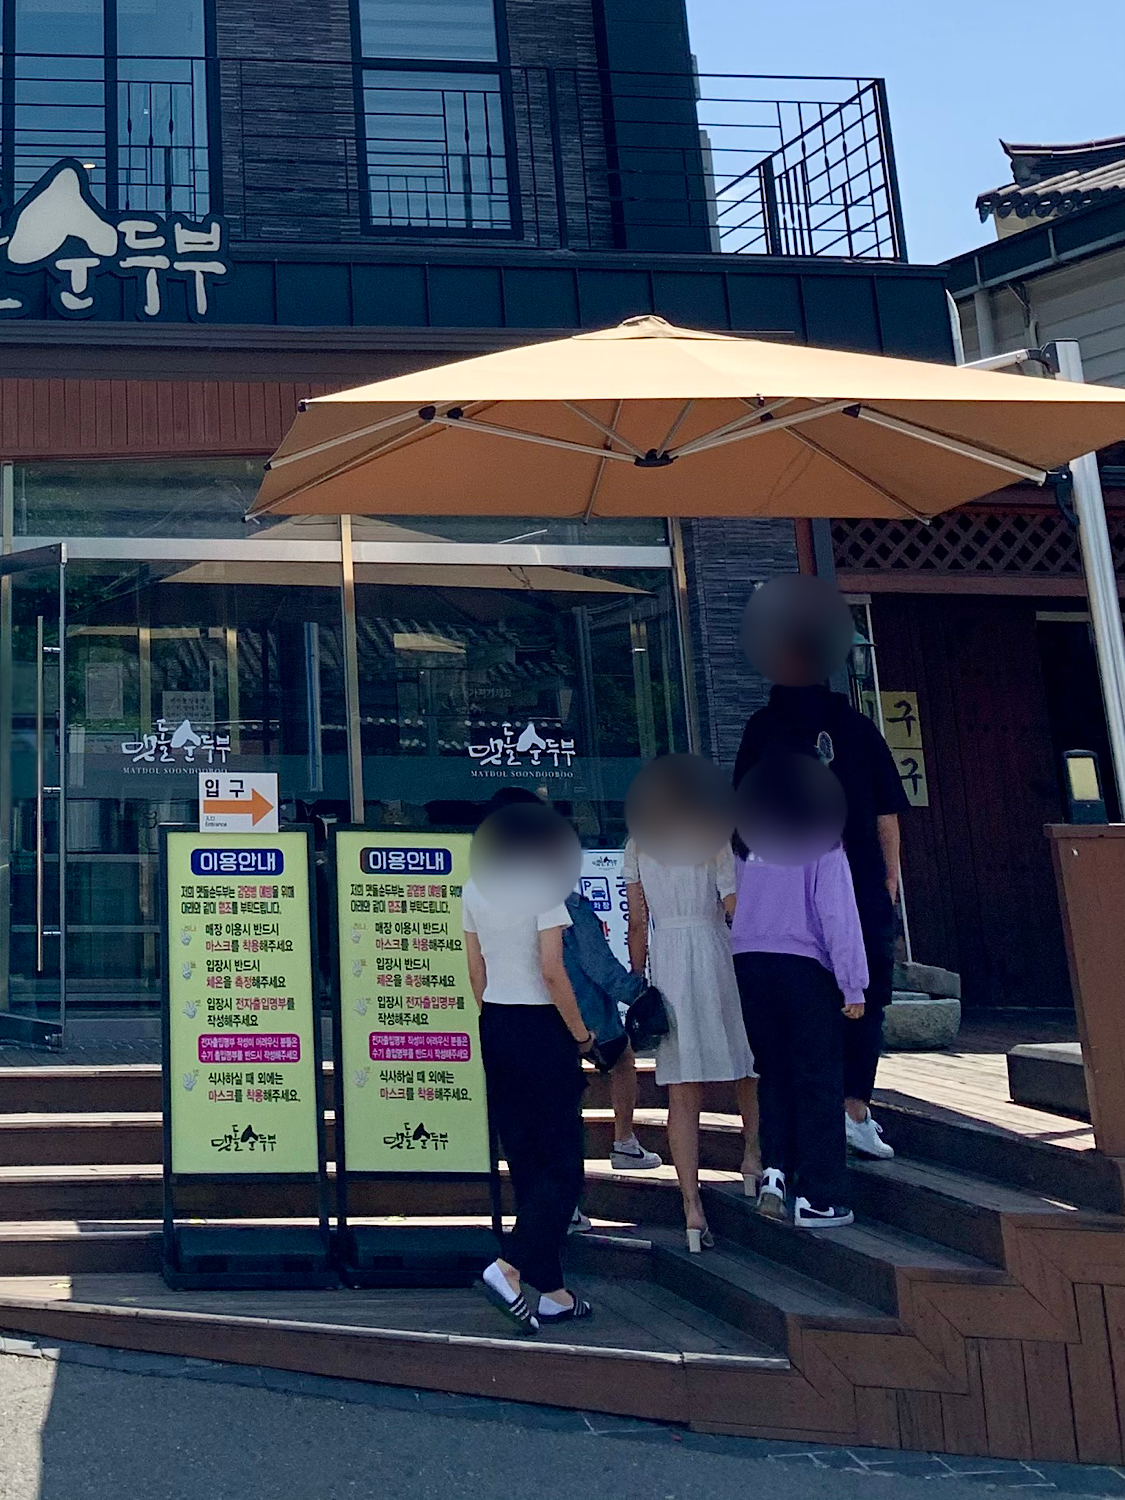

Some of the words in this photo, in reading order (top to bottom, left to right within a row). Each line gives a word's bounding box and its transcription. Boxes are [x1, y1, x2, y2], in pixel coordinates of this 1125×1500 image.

[121, 719, 231, 763] 맷돌순두부
[468, 723, 576, 767] 맷돌순두부
[471, 770, 508, 778] MATDOL
[510, 770, 574, 778] SOONDOOBOO
[200, 852, 276, 871] 이용안내
[369, 851, 444, 870] 이용안내
[281, 885, 295, 898] 위해
[593, 901, 610, 910] 차장
[205, 923, 223, 936] 매장
[225, 923, 251, 936] 이용시
[253, 923, 279, 936] 반드시
[375, 922, 392, 934] 매장
[395, 922, 420, 934] 이용시
[423, 922, 448, 934] 반드시
[206, 940, 239, 952] 마스크를
[242, 940, 294, 952] 착용해주세요
[376, 939, 409, 951] 마스크를
[413, 939, 462, 951] 착용해주세요
[206, 960, 232, 972] 입장시
[235, 960, 260, 972] 반드시
[376, 958, 401, 970] 입장시
[404, 958, 430, 970] 반드시
[206, 976, 232, 989] 체온을
[235, 976, 286, 989] 측정해주세요
[377, 974, 402, 987] 체온을
[405, 974, 456, 987] 측정해주세요
[207, 998, 232, 1011] 입장시
[235, 998, 295, 1011] 전자출입명부를
[377, 996, 403, 1009] 입장시
[406, 996, 465, 1009] 전자출입명부를
[207, 1015, 259, 1028] 작성해주세요
[378, 1013, 429, 1025] 작성해주세요
[201, 1037, 235, 1048] 전자출입명부
[372, 1036, 406, 1047] 전자출입명부
[201, 1050, 213, 1061] 수기
[215, 1050, 243, 1061] 출입명부를
[244, 1050, 262, 1061] 반드시
[263, 1050, 298, 1061] 작성해주세요
[372, 1048, 384, 1059] 수기
[386, 1048, 413, 1059] 출입명부를
[415, 1048, 433, 1059] 반드시
[435, 1048, 469, 1059] 작성해주세요
[208, 1072, 243, 1085] 식사하실
[246, 1072, 254, 1085] 때
[257, 1072, 284, 1085] 외에는
[379, 1070, 414, 1083] 식사하실
[417, 1070, 425, 1083] 때
[428, 1070, 455, 1083] 외에는
[208, 1089, 242, 1102] 마스크를
[246, 1089, 301, 1102] 착용해주세요.
[380, 1087, 414, 1101] 마스크를
[417, 1087, 472, 1101] 착용해주세요.
[211, 1124, 277, 1152] 맷돌순두부
[383, 1122, 449, 1150] 맷돌순두부
